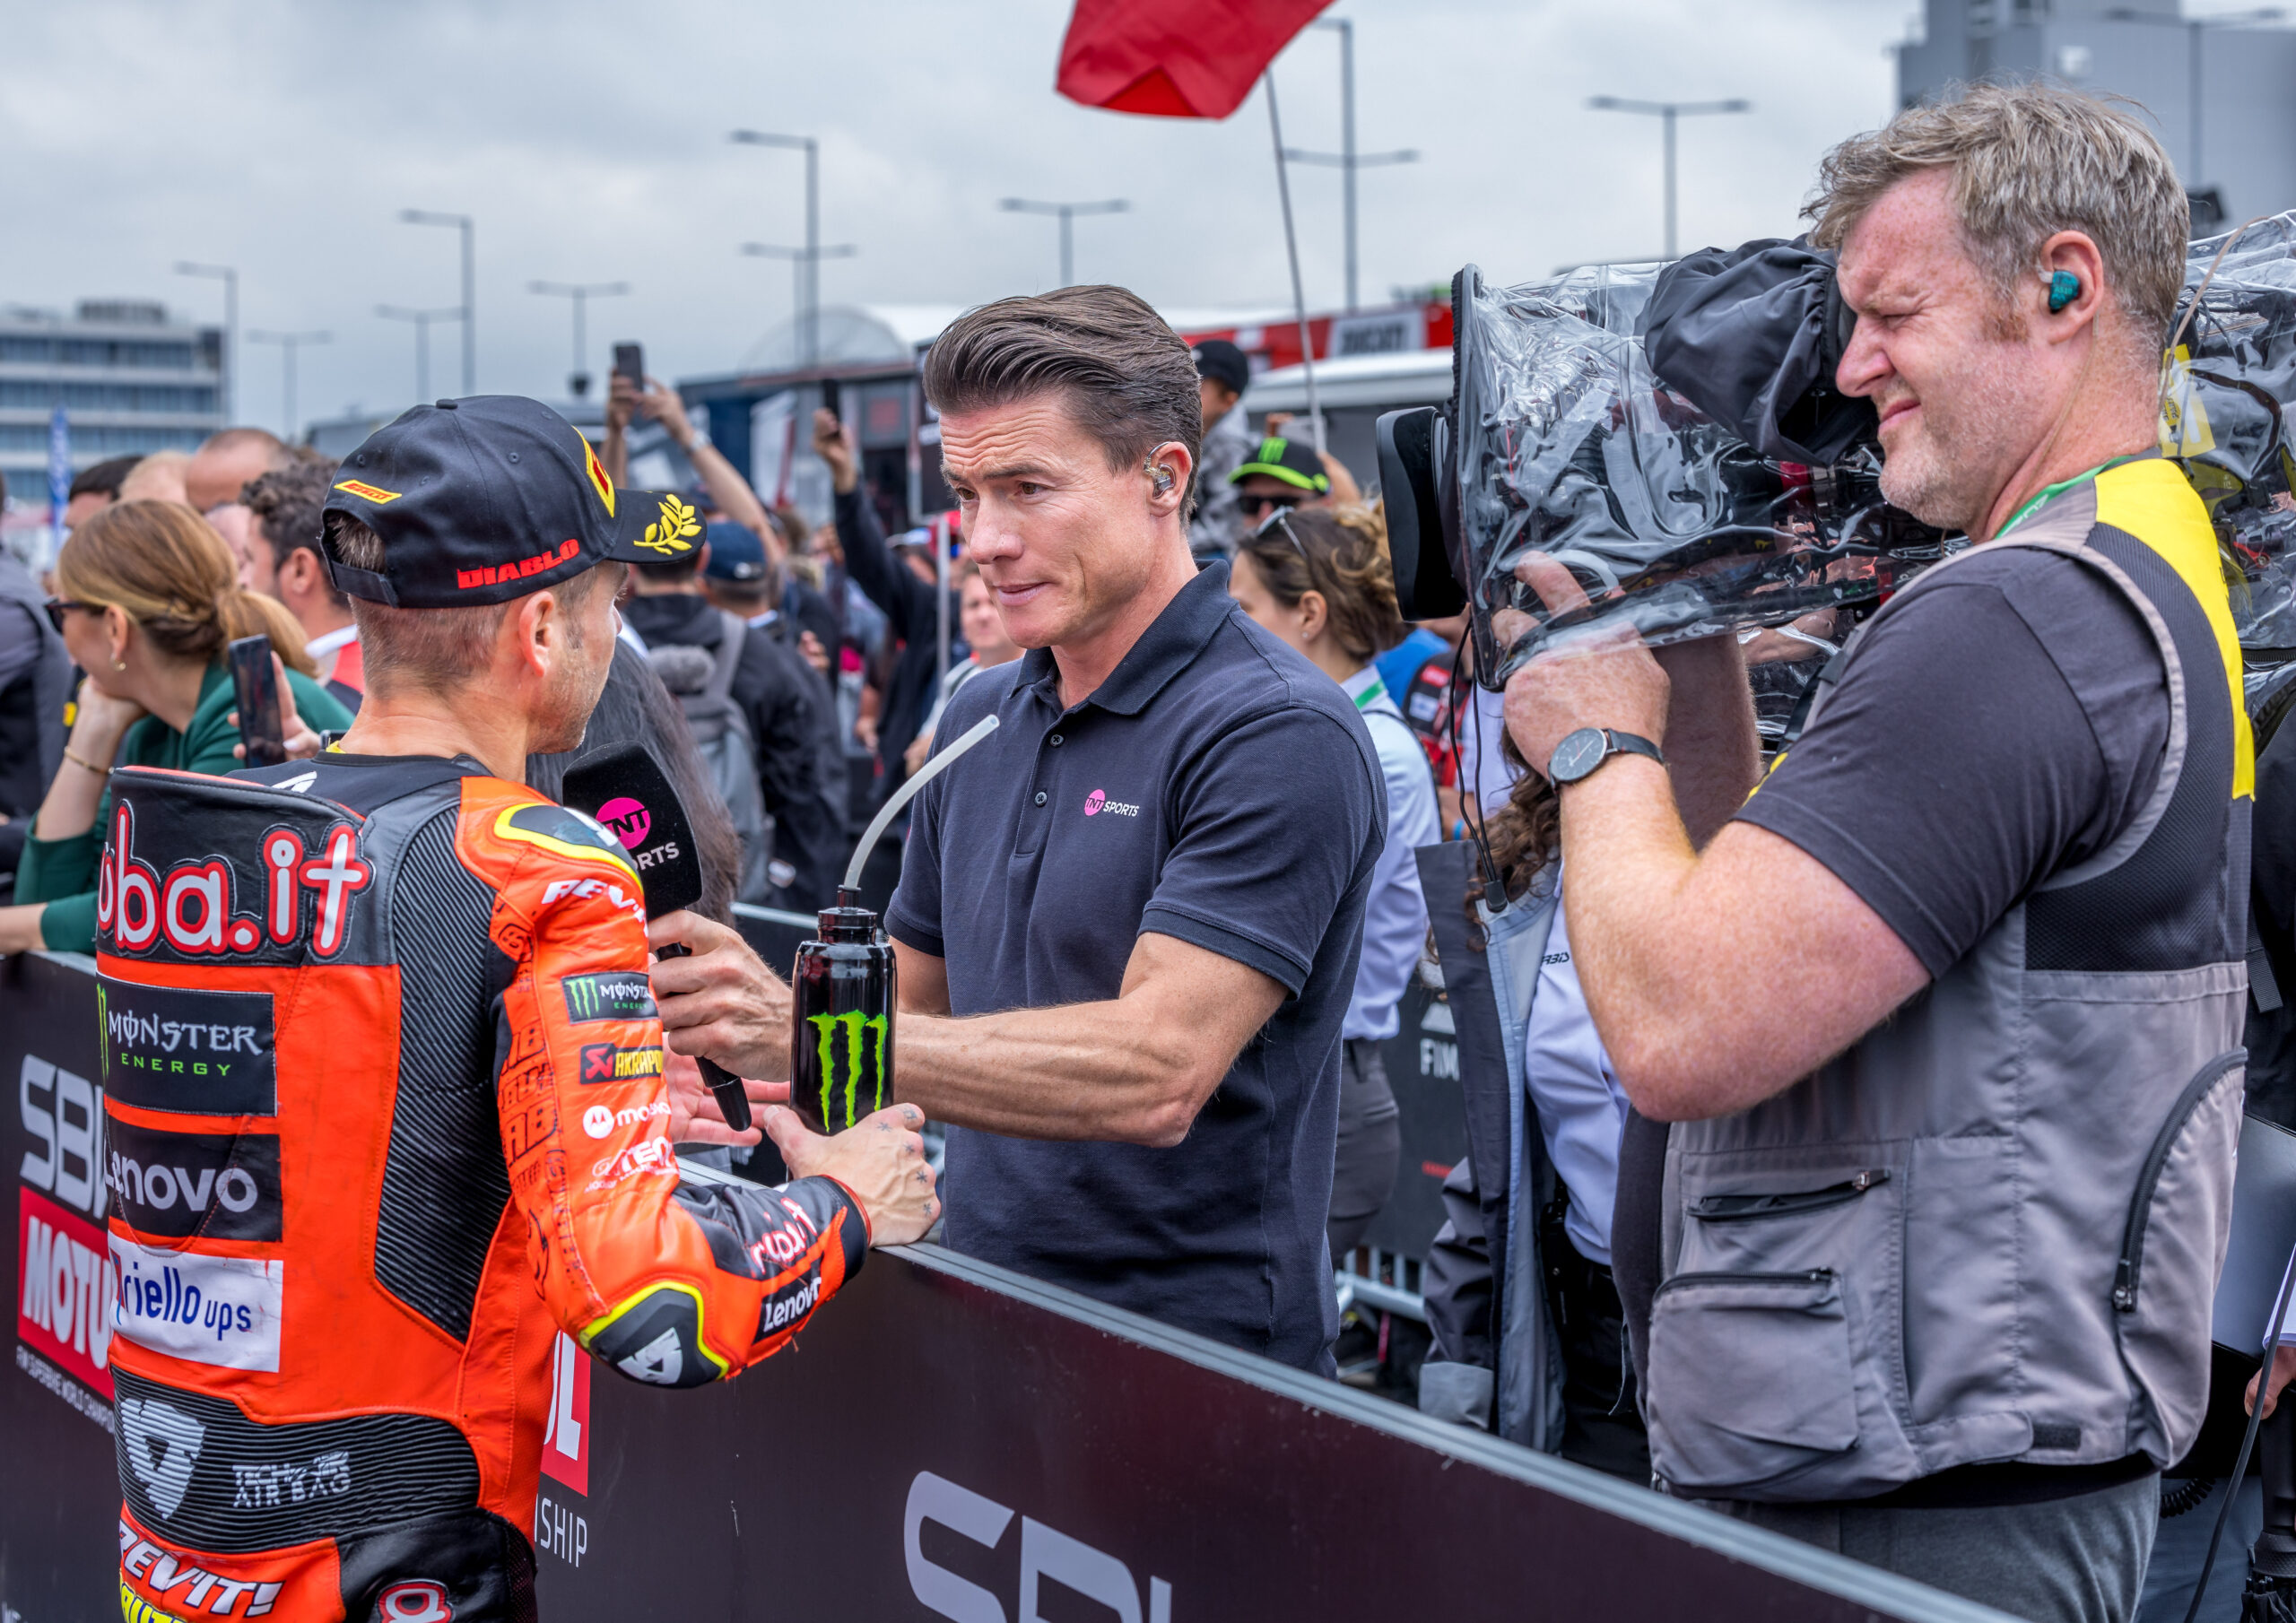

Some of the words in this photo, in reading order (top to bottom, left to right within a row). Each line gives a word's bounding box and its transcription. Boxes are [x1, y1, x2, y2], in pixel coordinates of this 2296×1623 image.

[457, 538, 580, 589] DIABLO
[1103, 801, 1139, 817] SPORTS
[121, 1053, 231, 1076] ENERGY
[22, 1214, 110, 1370] MOTU
[124, 1262, 202, 1324] riello
[204, 1300, 252, 1341] ups
